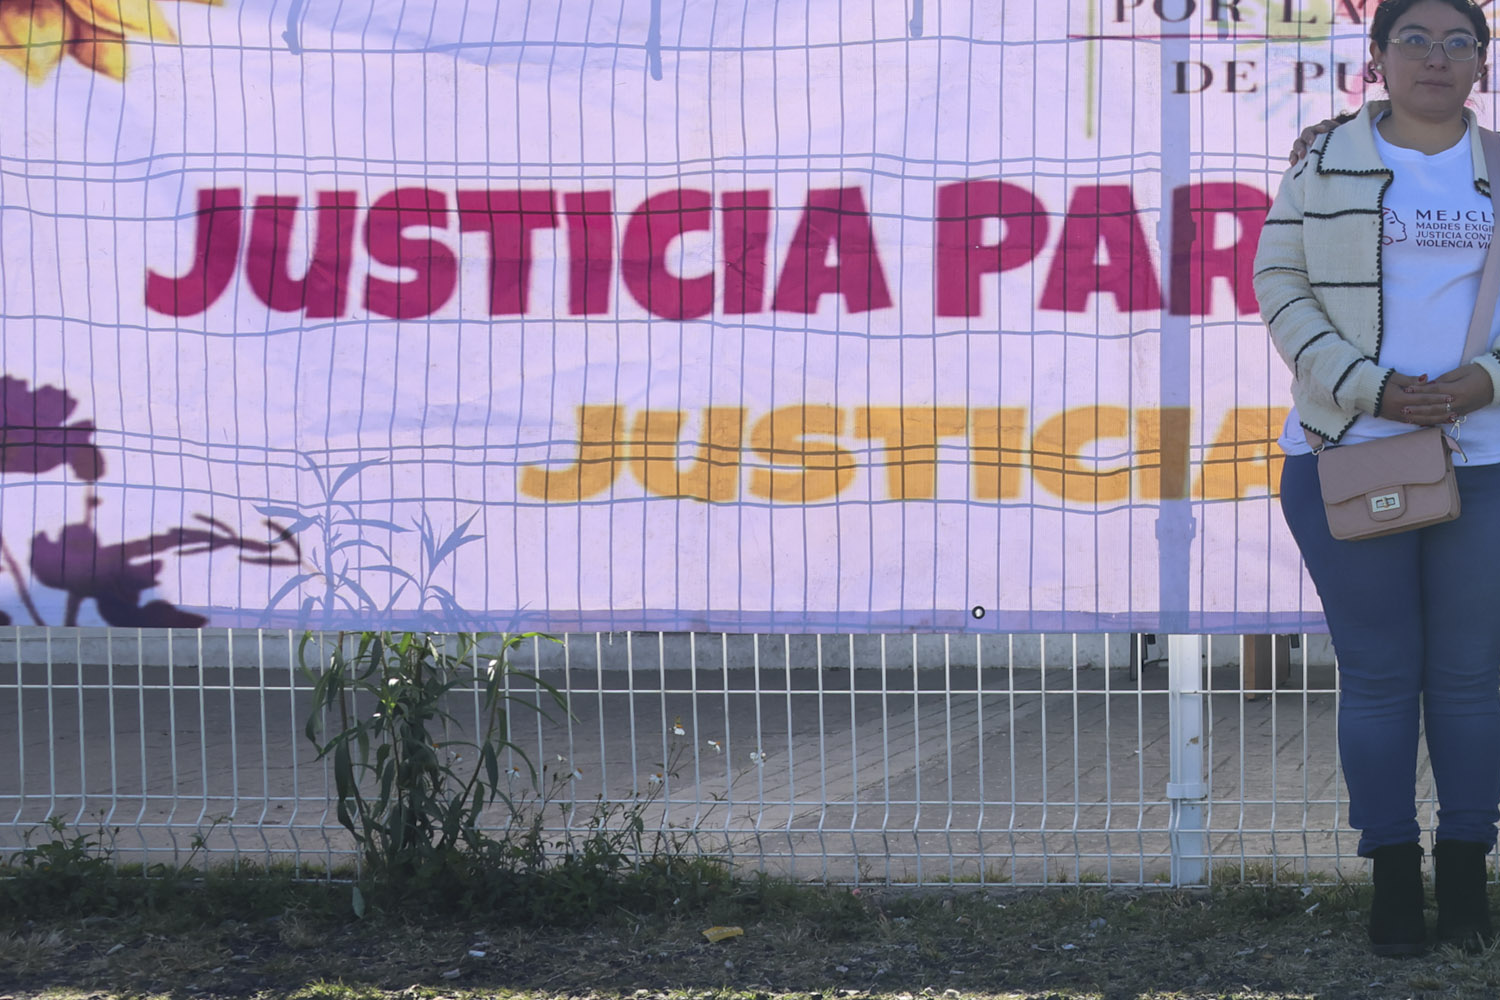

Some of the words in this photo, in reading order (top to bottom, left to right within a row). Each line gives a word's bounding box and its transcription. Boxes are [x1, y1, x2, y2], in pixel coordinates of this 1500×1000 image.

[1172, 59, 1257, 95] DE
[1415, 209, 1495, 223] MEJCL
[1415, 222, 1461, 231] MADRES
[1415, 231, 1462, 240] JUSTICIA
[1465, 232, 1493, 242] CONT
[144, 186, 891, 320] JUSTICIA
[936, 180, 1274, 317] PAR
[1415, 239, 1474, 249] VIOLENCIA
